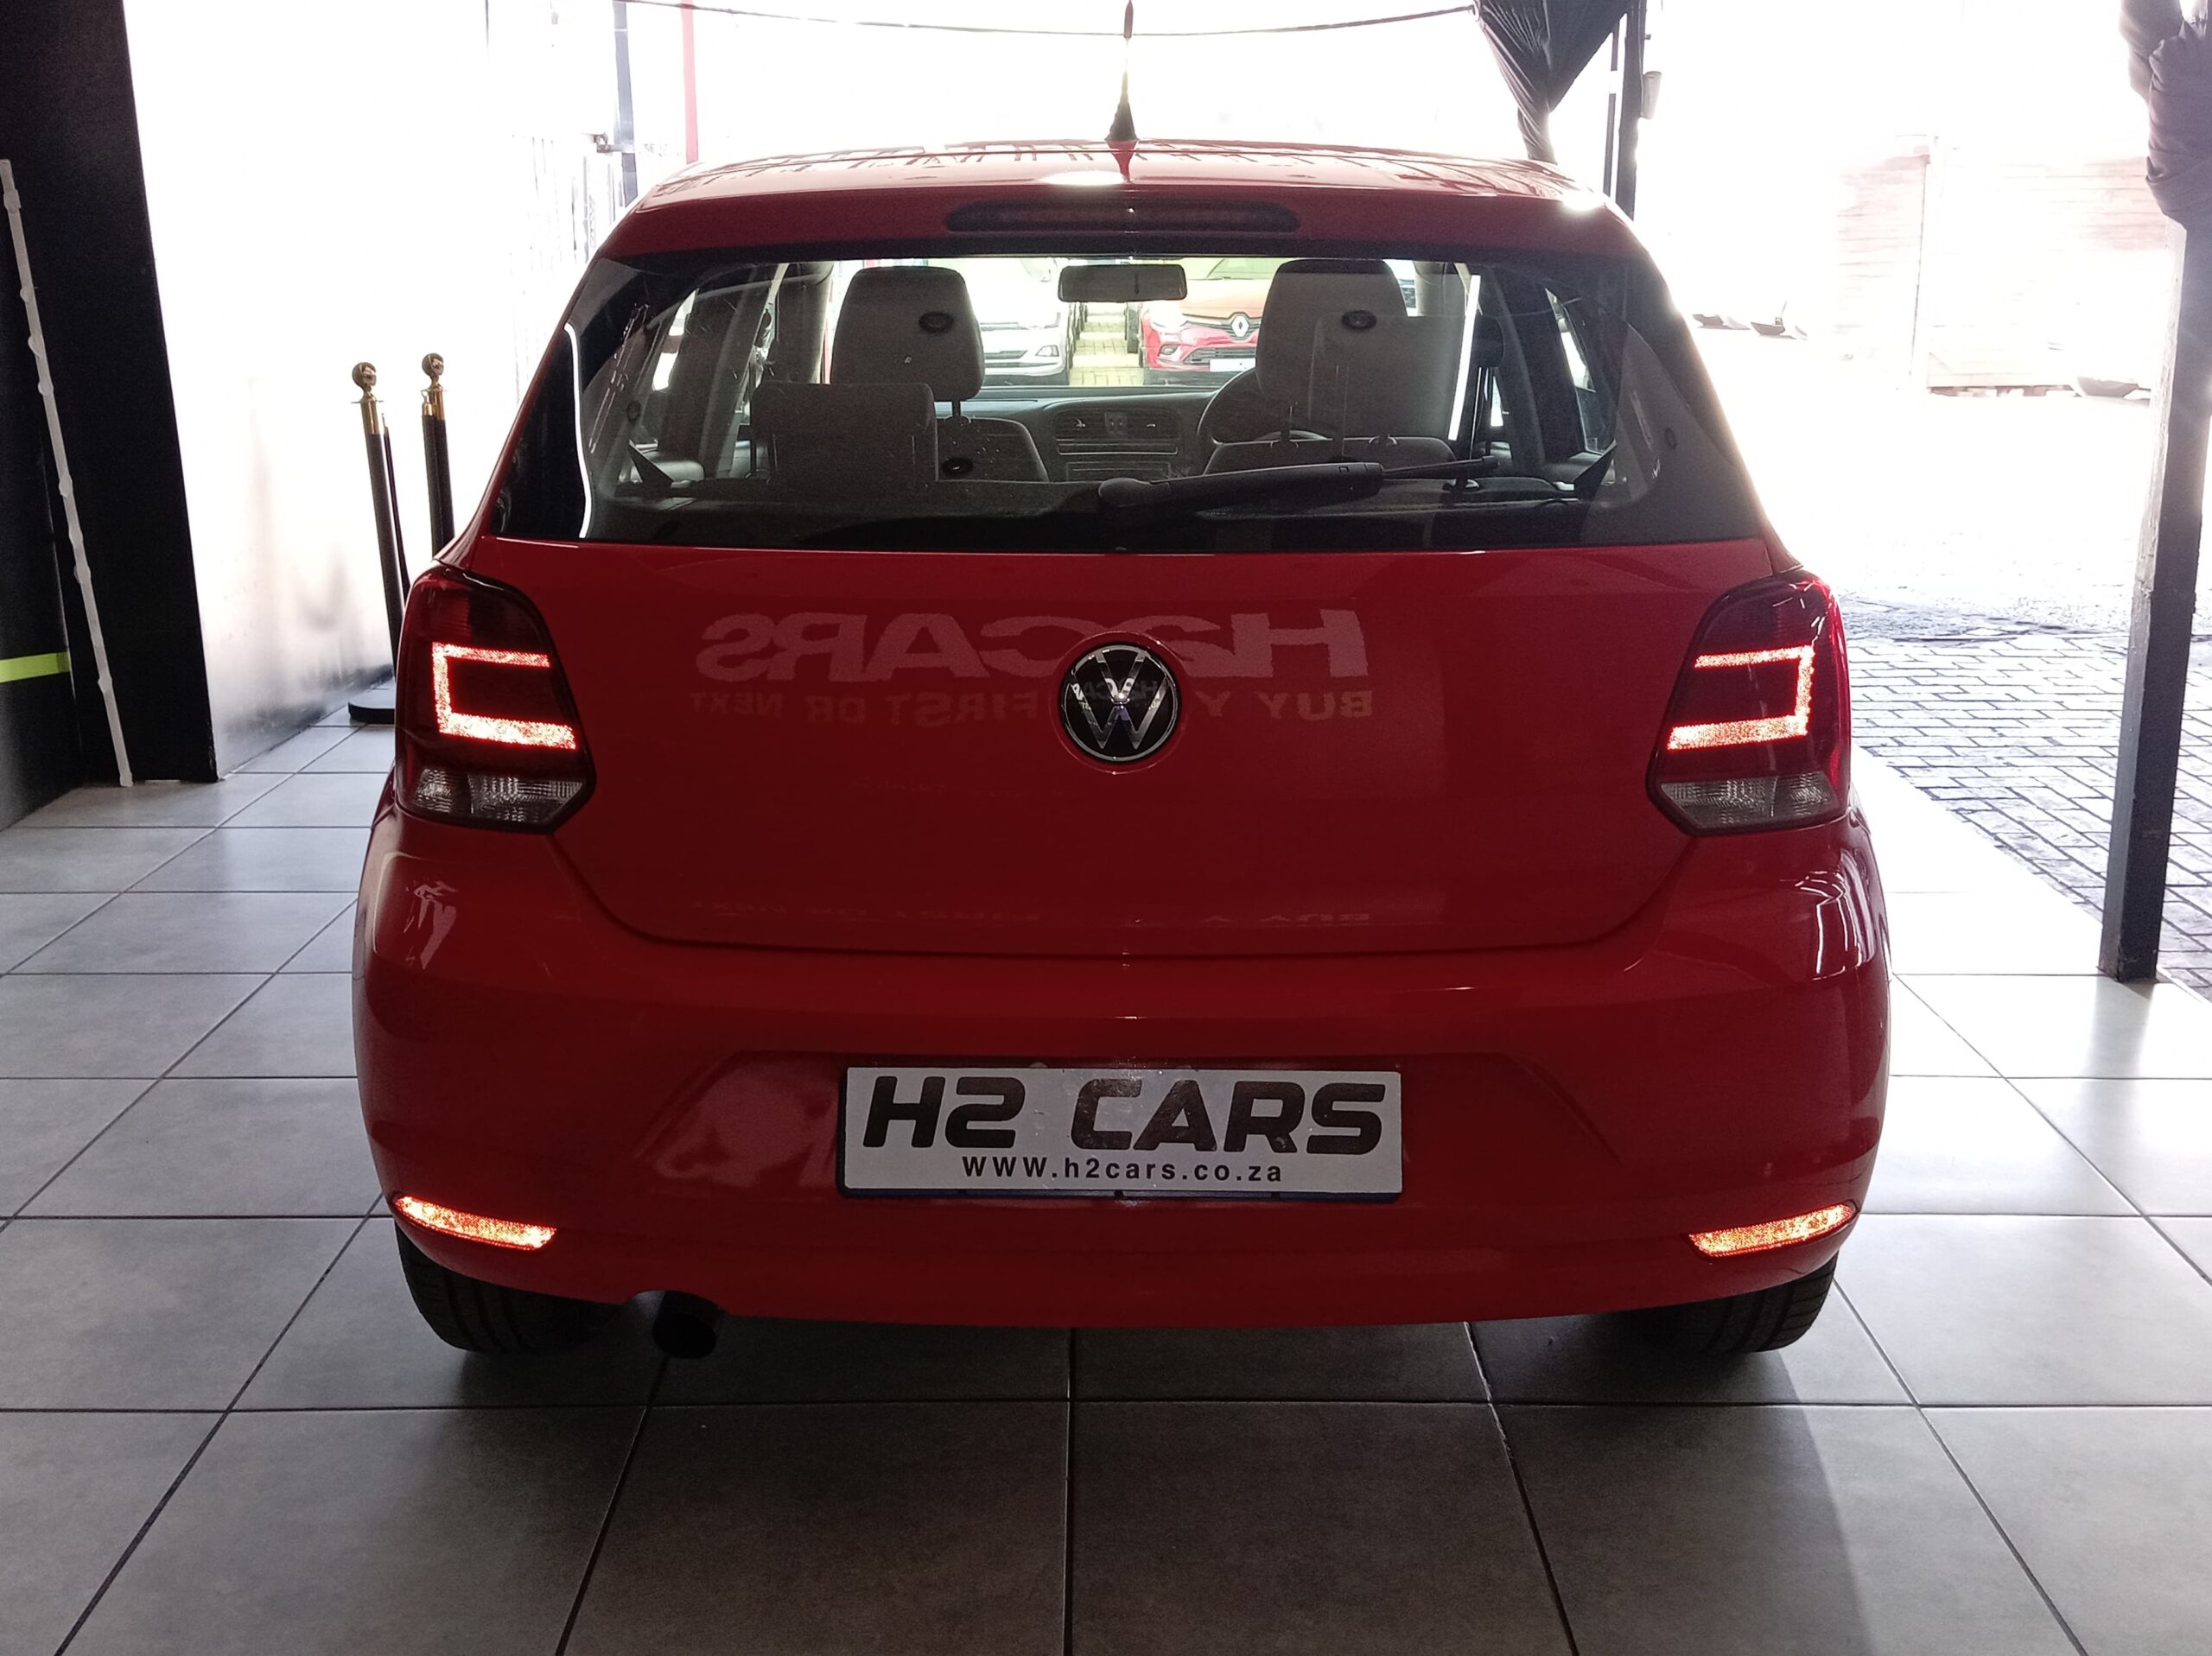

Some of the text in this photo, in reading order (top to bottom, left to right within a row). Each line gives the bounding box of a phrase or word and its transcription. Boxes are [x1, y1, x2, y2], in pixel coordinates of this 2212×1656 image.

[862, 1075, 1386, 1155] H2 CARS
[961, 1155, 1282, 1183] www.h2cars.co.za
